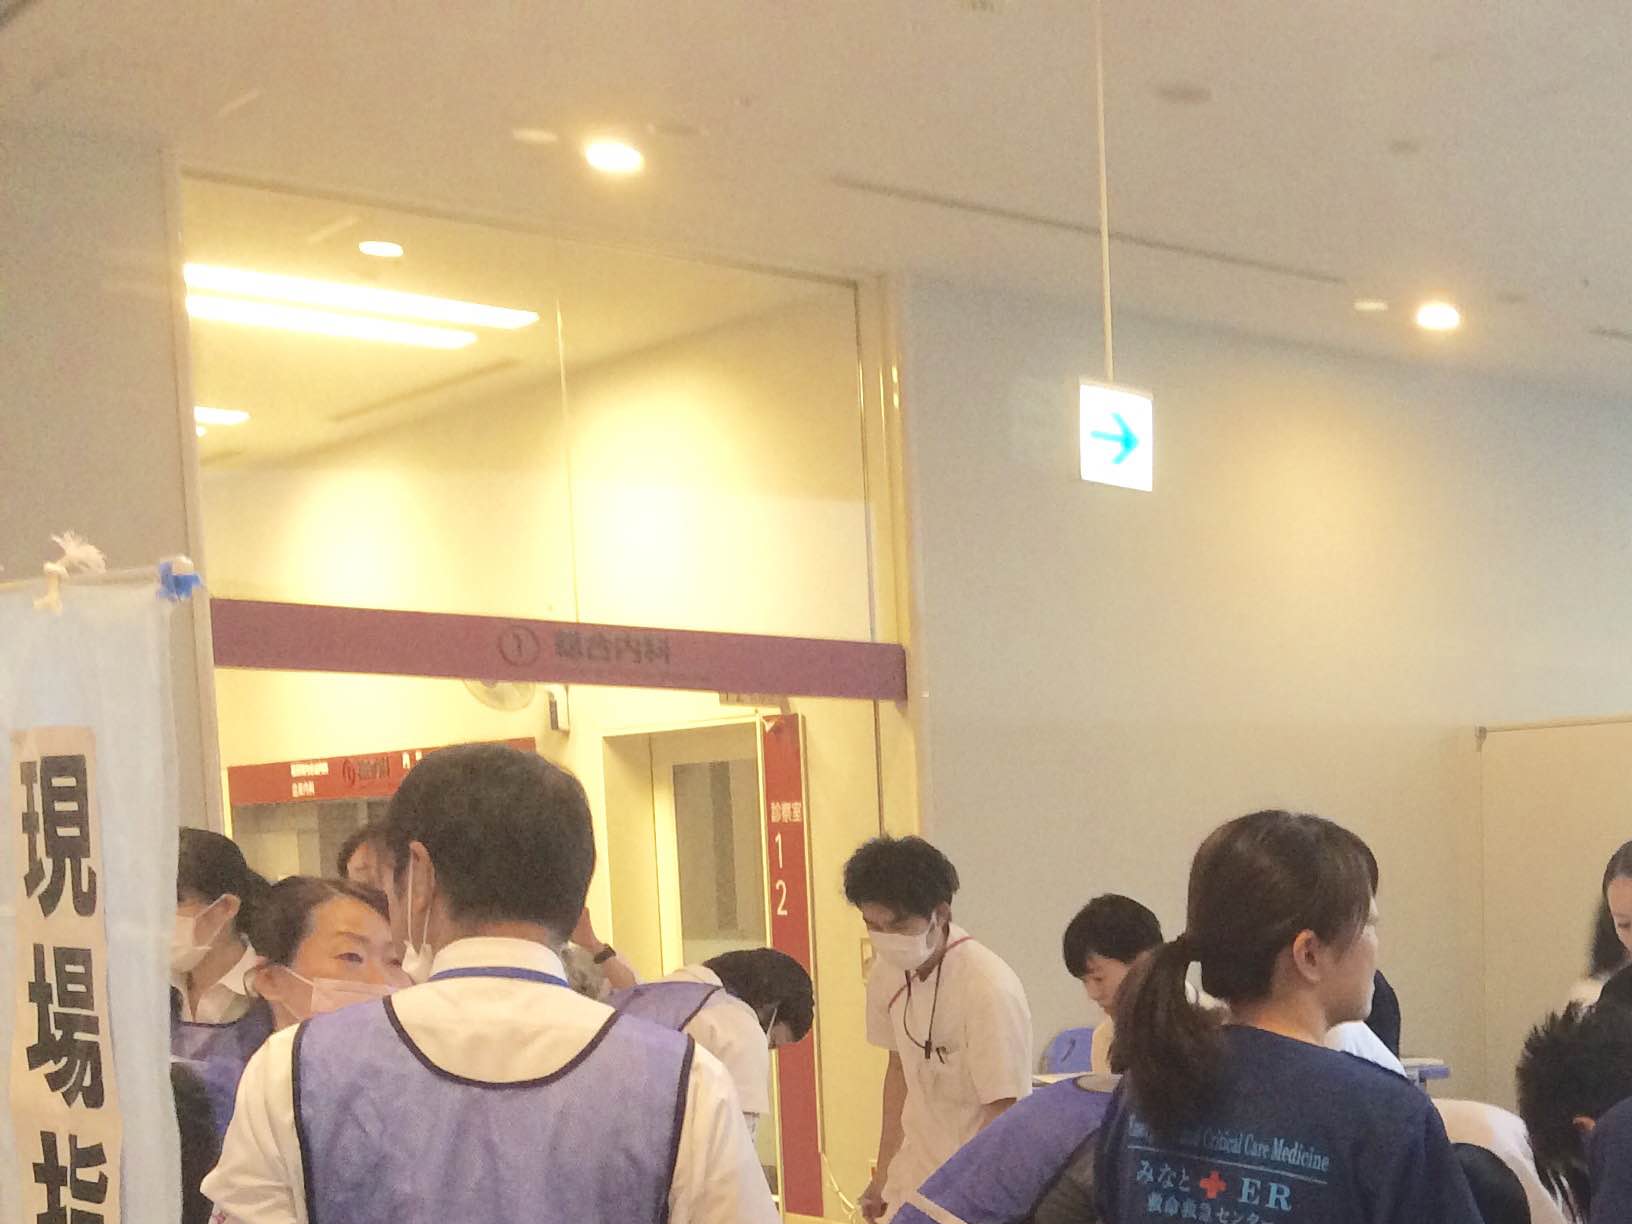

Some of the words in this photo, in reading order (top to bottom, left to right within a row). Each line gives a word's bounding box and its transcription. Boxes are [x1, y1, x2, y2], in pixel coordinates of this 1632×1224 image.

[774, 832, 783, 869] 1
[775, 879, 788, 916] 2
[1244, 1133, 1270, 1159] Care
[1270, 1137, 1330, 1172] Medicine
[1136, 1160, 1190, 1192] みなと
[1238, 1177, 1292, 1212] ER
